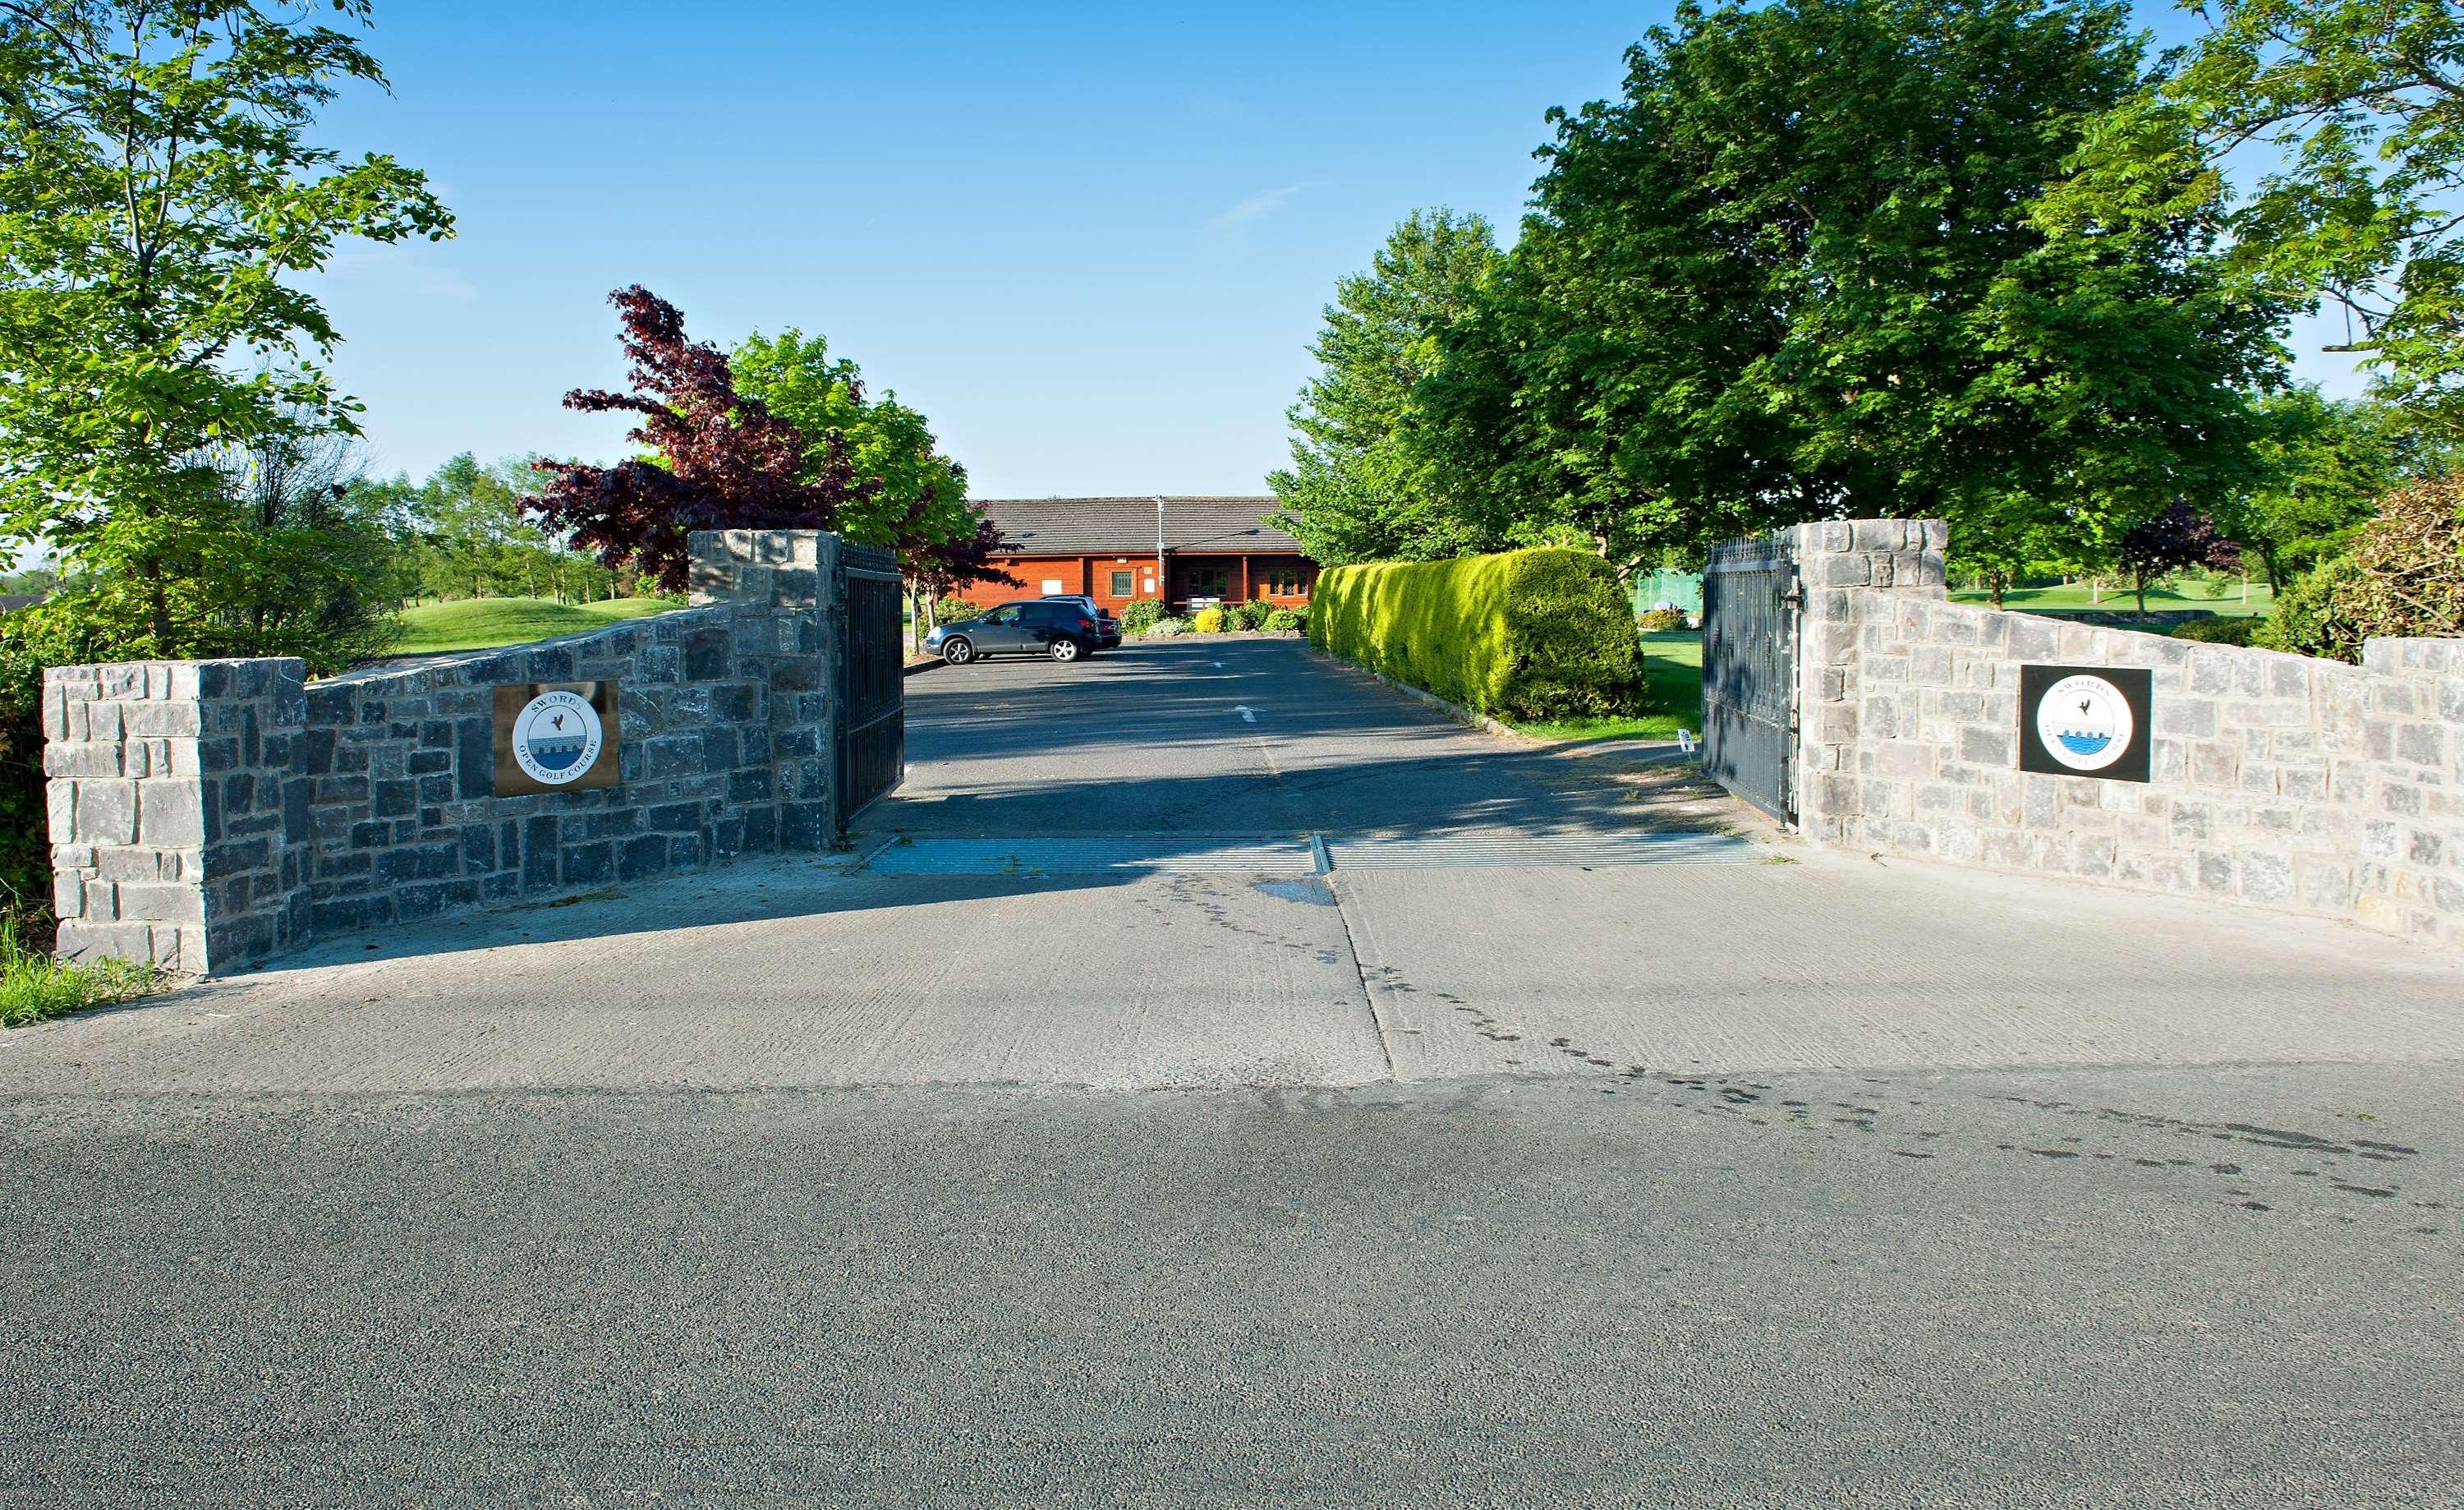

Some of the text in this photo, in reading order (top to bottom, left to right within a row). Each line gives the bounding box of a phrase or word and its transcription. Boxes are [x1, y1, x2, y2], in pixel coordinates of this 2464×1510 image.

[531, 695, 584, 712] SWORDS
[520, 740, 597, 780] OPEN GOLF COURSE
